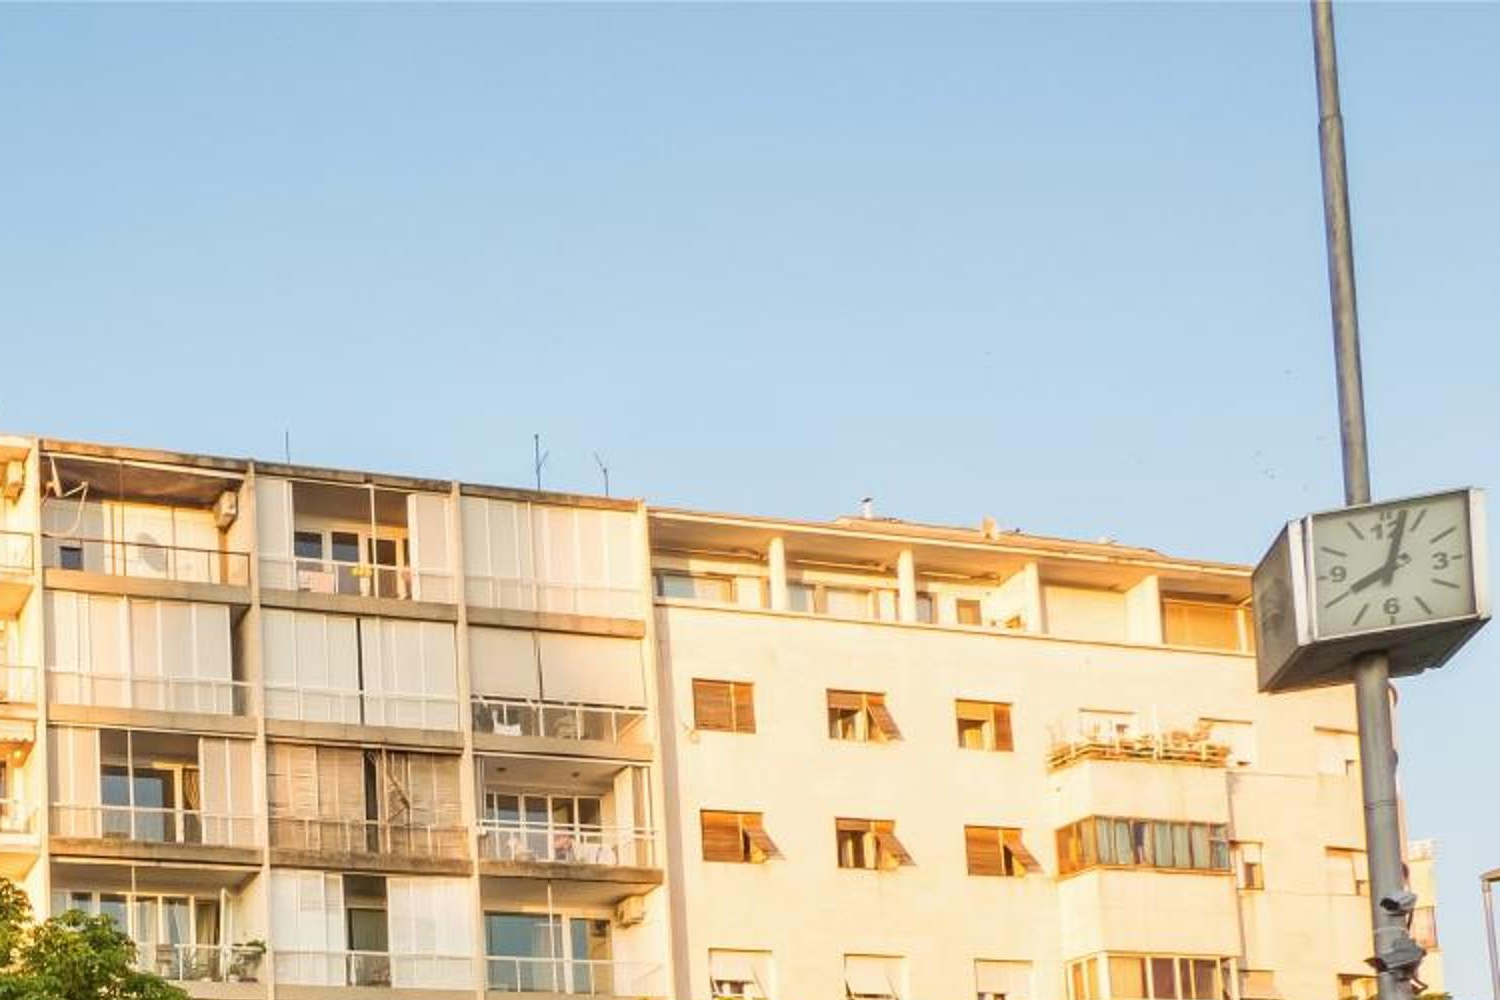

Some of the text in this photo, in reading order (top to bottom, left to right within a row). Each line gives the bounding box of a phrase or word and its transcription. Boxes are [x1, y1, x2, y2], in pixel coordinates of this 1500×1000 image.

[1431, 551, 1449, 571] 3
[1329, 564, 1348, 583] 9
[1382, 597, 1400, 615] 6
